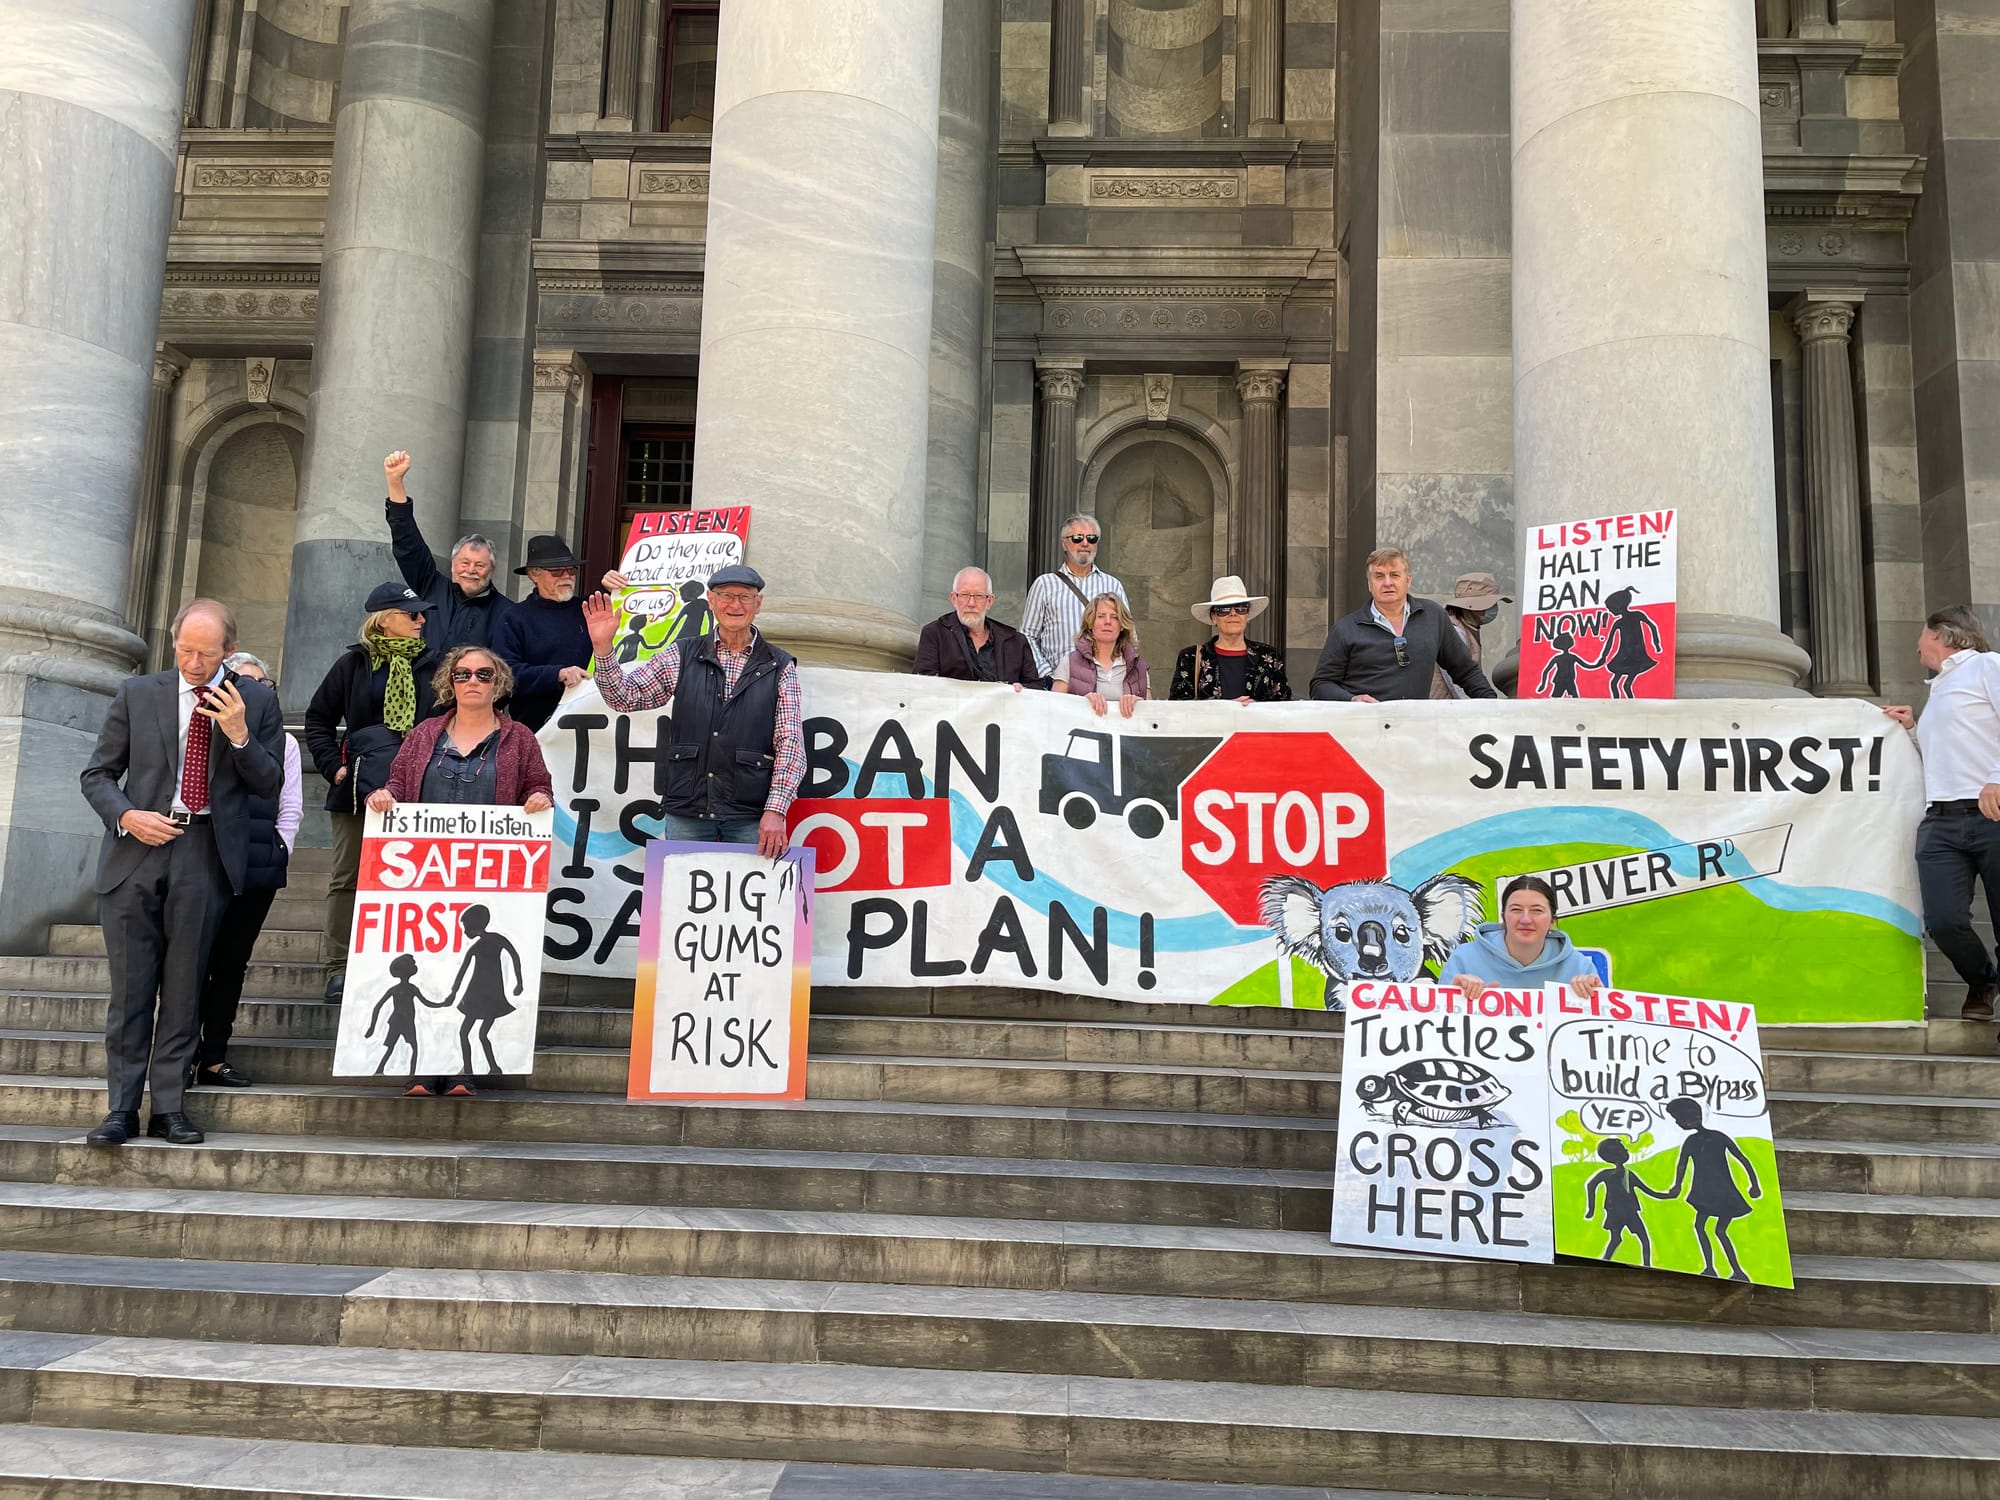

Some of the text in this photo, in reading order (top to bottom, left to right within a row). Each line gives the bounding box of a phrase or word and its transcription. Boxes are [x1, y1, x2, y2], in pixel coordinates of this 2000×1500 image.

[639, 507, 745, 534] LISTEN!
[1538, 510, 1674, 550] LISTEN!
[635, 539, 736, 563] Do they care
[666, 562, 685, 580] the
[1540, 541, 1661, 580] HALT THE
[628, 593, 673, 613] or us?
[1538, 579, 1600, 611] BAN
[1534, 611, 1610, 643] NOW!
[557, 714, 1000, 804] TH BAN
[1469, 734, 1884, 793] SAFETY FIRST!
[382, 808, 552, 838] It's time to listen...
[561, 798, 1034, 890] IS OT A
[1190, 790, 1370, 867] STOP
[378, 840, 547, 889] SAFETY
[1550, 852, 1677, 908] RIVER
[688, 870, 766, 923] BIG
[355, 902, 475, 953] FIRST
[674, 921, 783, 974] GUMS
[847, 895, 1157, 991] PLAN!
[705, 972, 741, 1002] AT
[1351, 983, 1544, 1029] CAUTION!
[1350, 1014, 1536, 1062] Turtles
[1559, 986, 1751, 1042] LISTEN!
[671, 1011, 778, 1069] RISK
[1578, 1025, 1716, 1069] Time to
[1561, 1058, 1759, 1111] build a Bypass
[1591, 1103, 1645, 1130] YEP
[1350, 1130, 1543, 1191] CROSS
[1367, 1184, 1529, 1248] HERE
